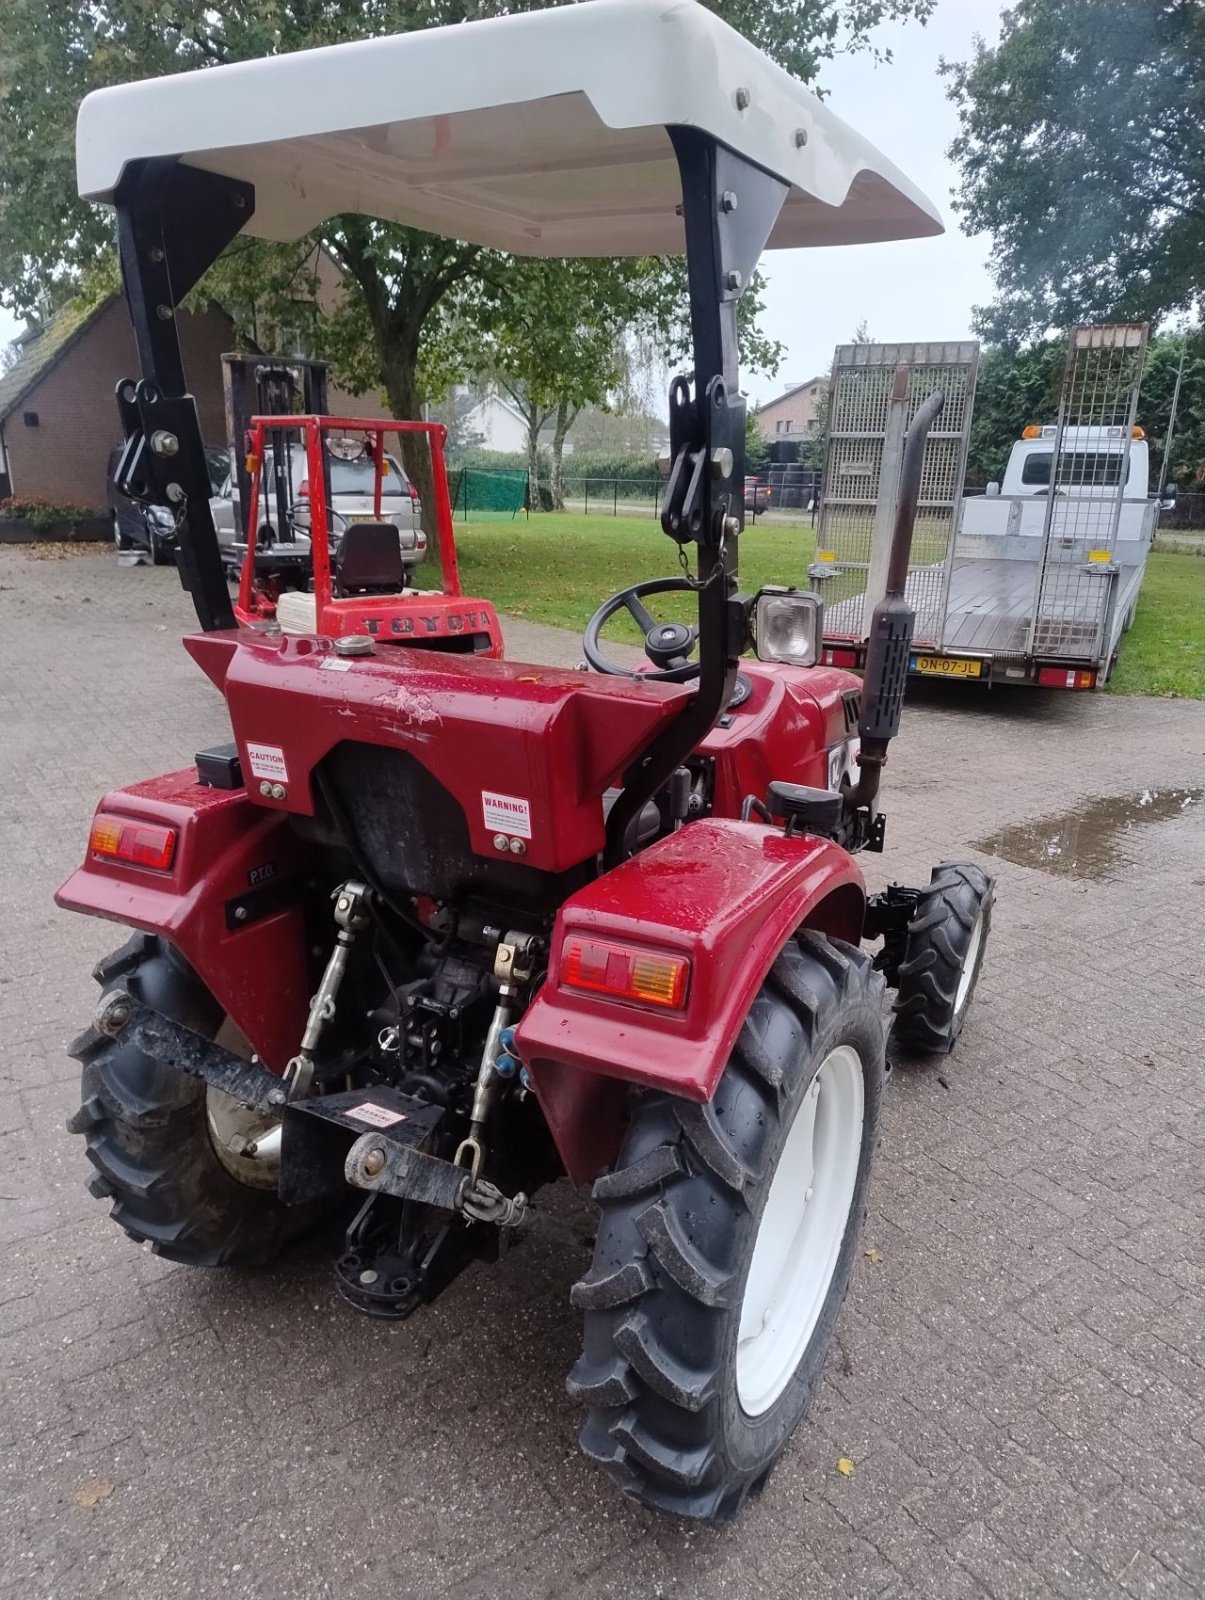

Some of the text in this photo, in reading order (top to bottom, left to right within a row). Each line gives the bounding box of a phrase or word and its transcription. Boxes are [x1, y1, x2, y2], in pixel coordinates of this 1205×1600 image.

[361, 611, 490, 634] TOYOTA
[920, 659, 975, 673] ON-07-JL
[249, 751, 283, 763] CAUTION
[484, 797, 527, 814] WARNING!
